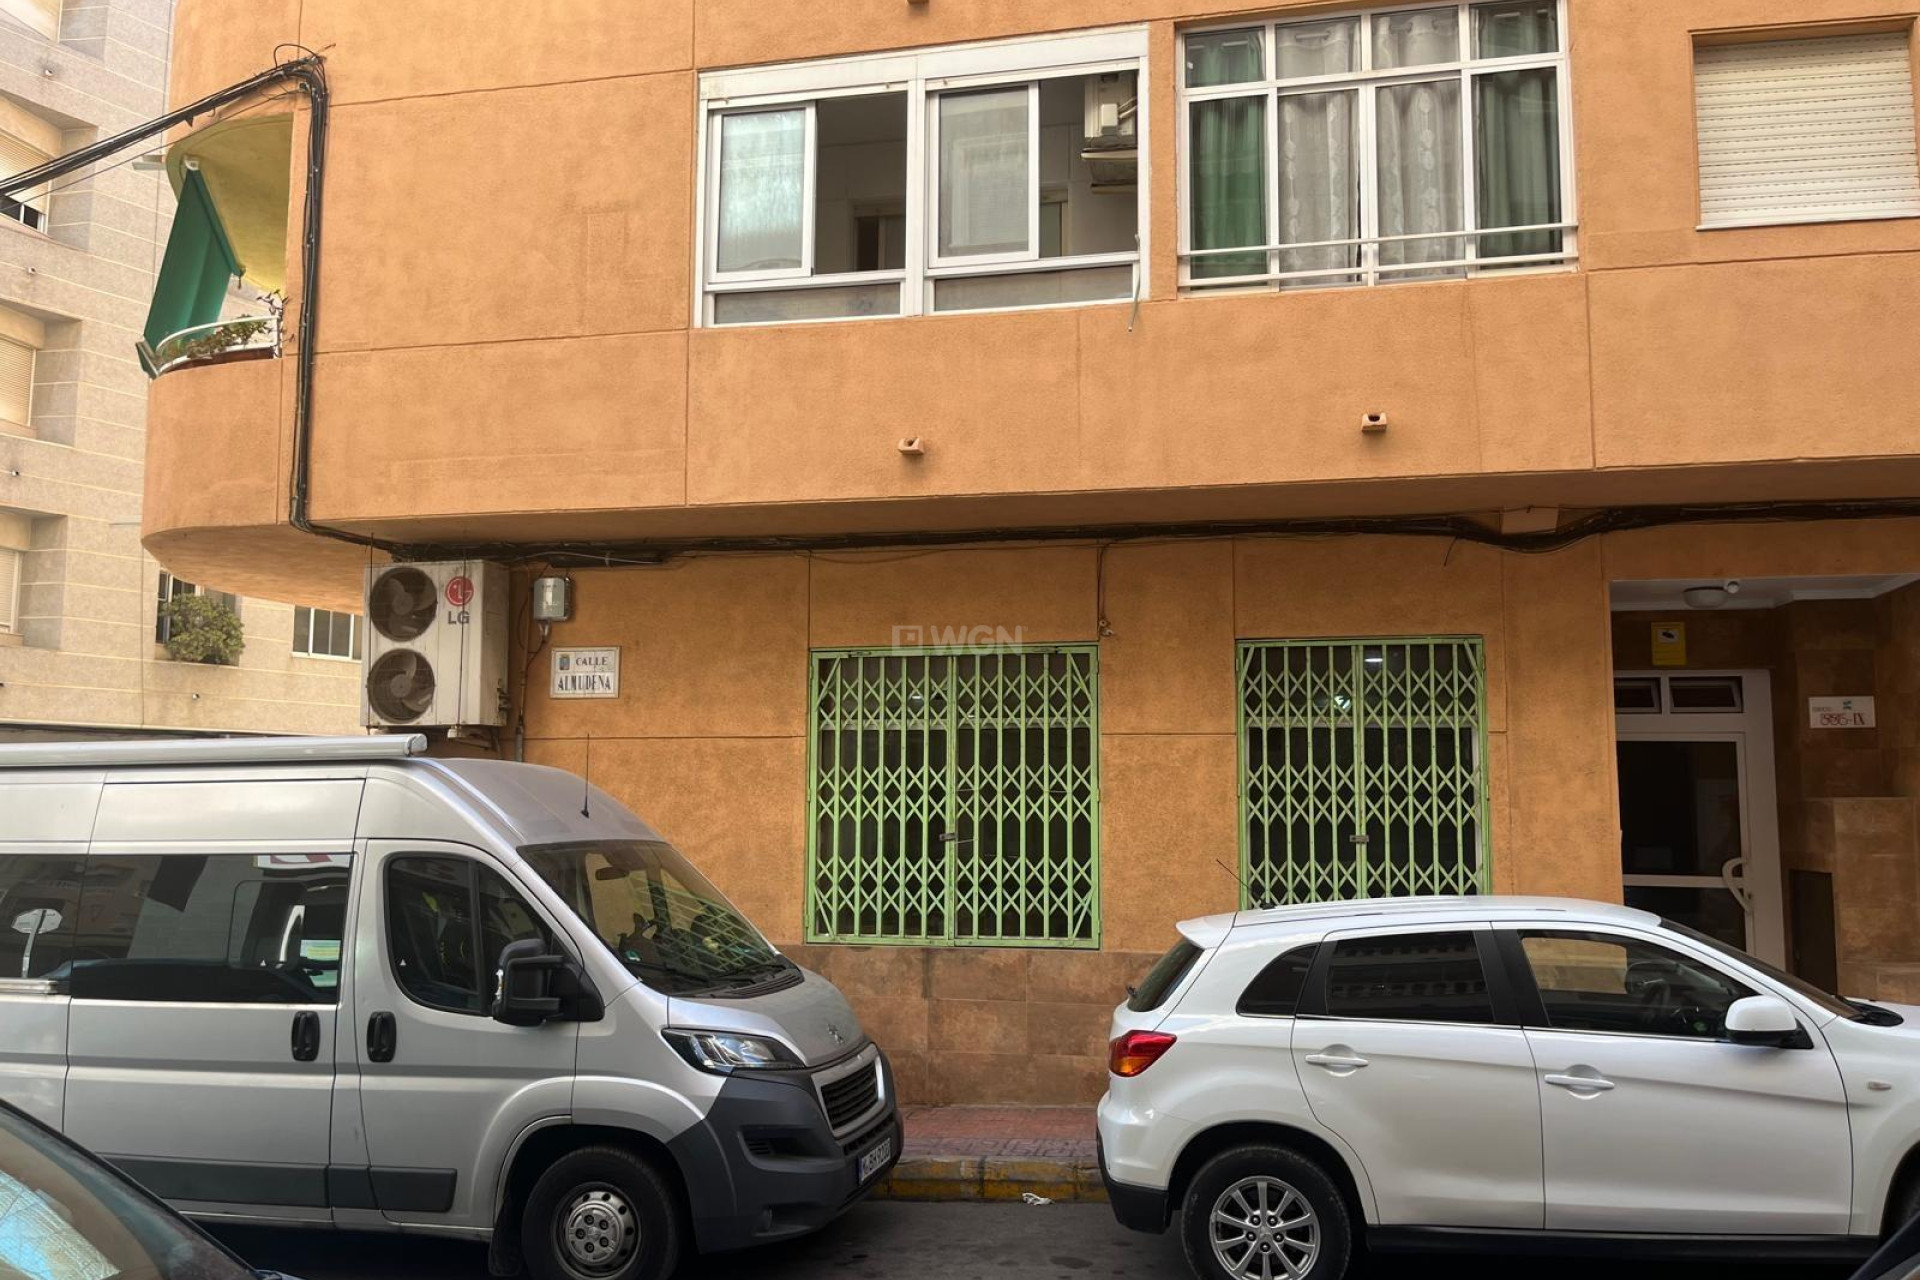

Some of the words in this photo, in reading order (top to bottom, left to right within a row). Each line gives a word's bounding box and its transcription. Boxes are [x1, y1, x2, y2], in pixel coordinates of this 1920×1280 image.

[448, 610, 470, 624] LG
[575, 656, 609, 666] CALLE
[557, 674, 611, 691] ALMUDENA
